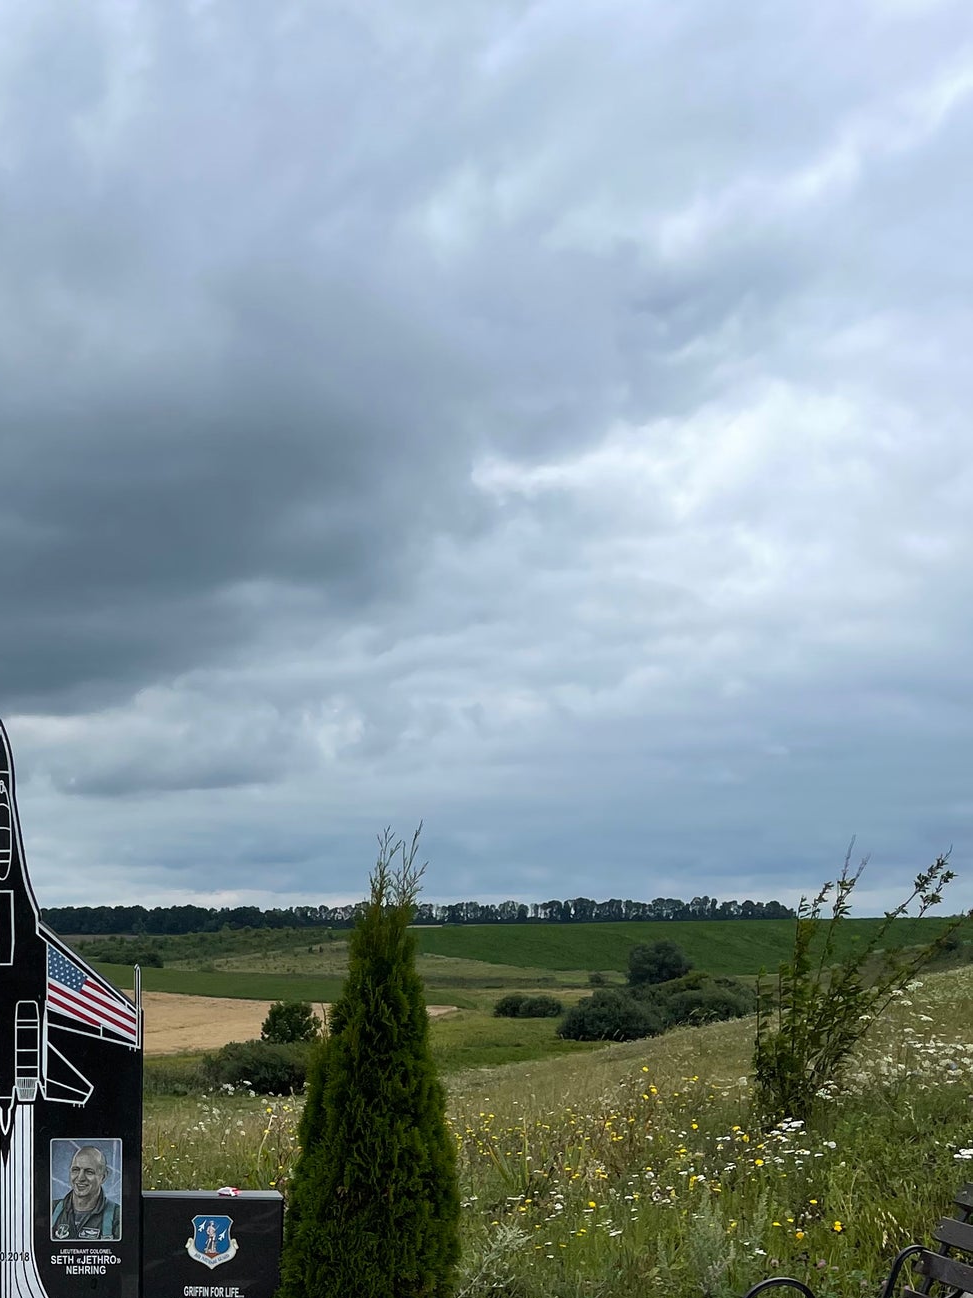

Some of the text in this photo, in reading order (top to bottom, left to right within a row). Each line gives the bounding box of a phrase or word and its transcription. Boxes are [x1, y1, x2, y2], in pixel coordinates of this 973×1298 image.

[50, 1255, 74, 1264] SETH
[65, 1265, 107, 1275] NEHRING
[183, 1286, 209, 1297] GRIFFIN
[210, 1286, 224, 1297] FOR
